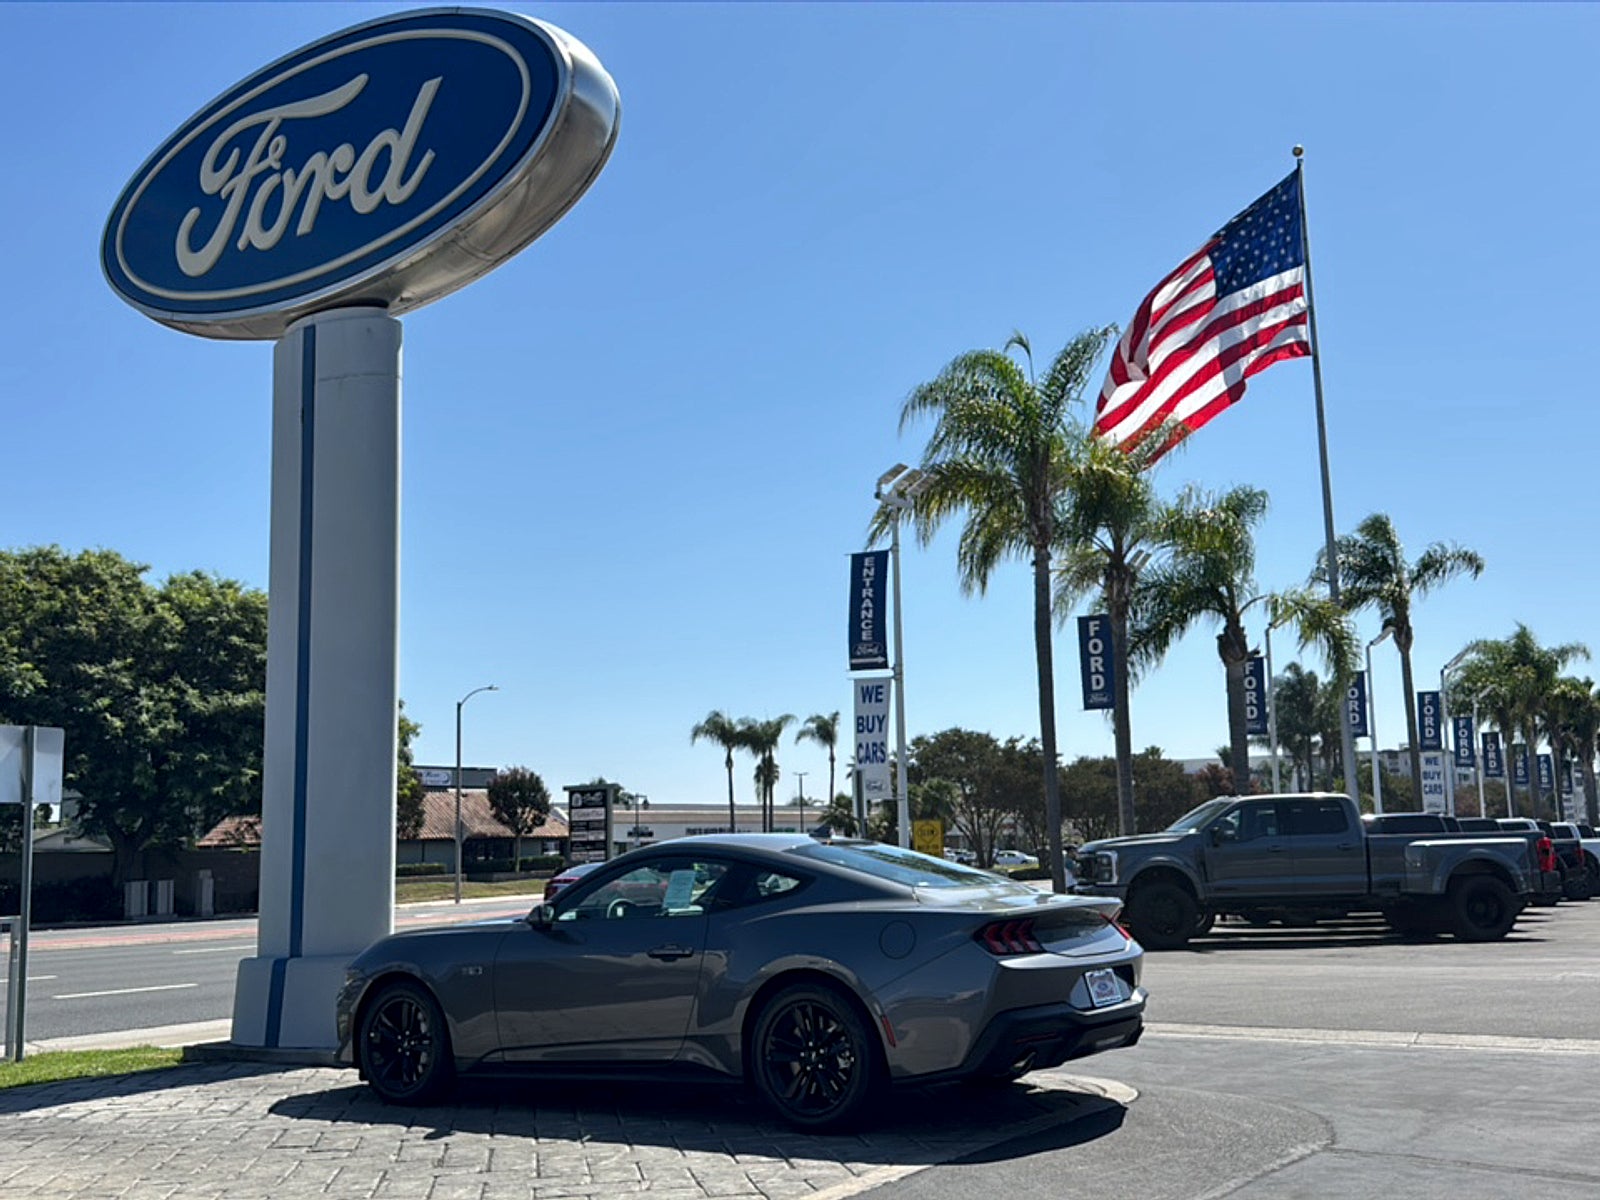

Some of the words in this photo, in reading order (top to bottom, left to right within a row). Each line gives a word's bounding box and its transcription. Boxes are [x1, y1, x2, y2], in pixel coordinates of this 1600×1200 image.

[175, 73, 443, 277] Ford
[861, 557, 875, 641] ENTRANCE
[1088, 620, 1105, 691] FORD
[861, 685, 884, 704] WE
[1243, 661, 1258, 720] FORD
[856, 714, 886, 734] BUY
[1423, 694, 1435, 738] FORD
[1458, 719, 1470, 757] FORD
[856, 742, 886, 764] CARS
